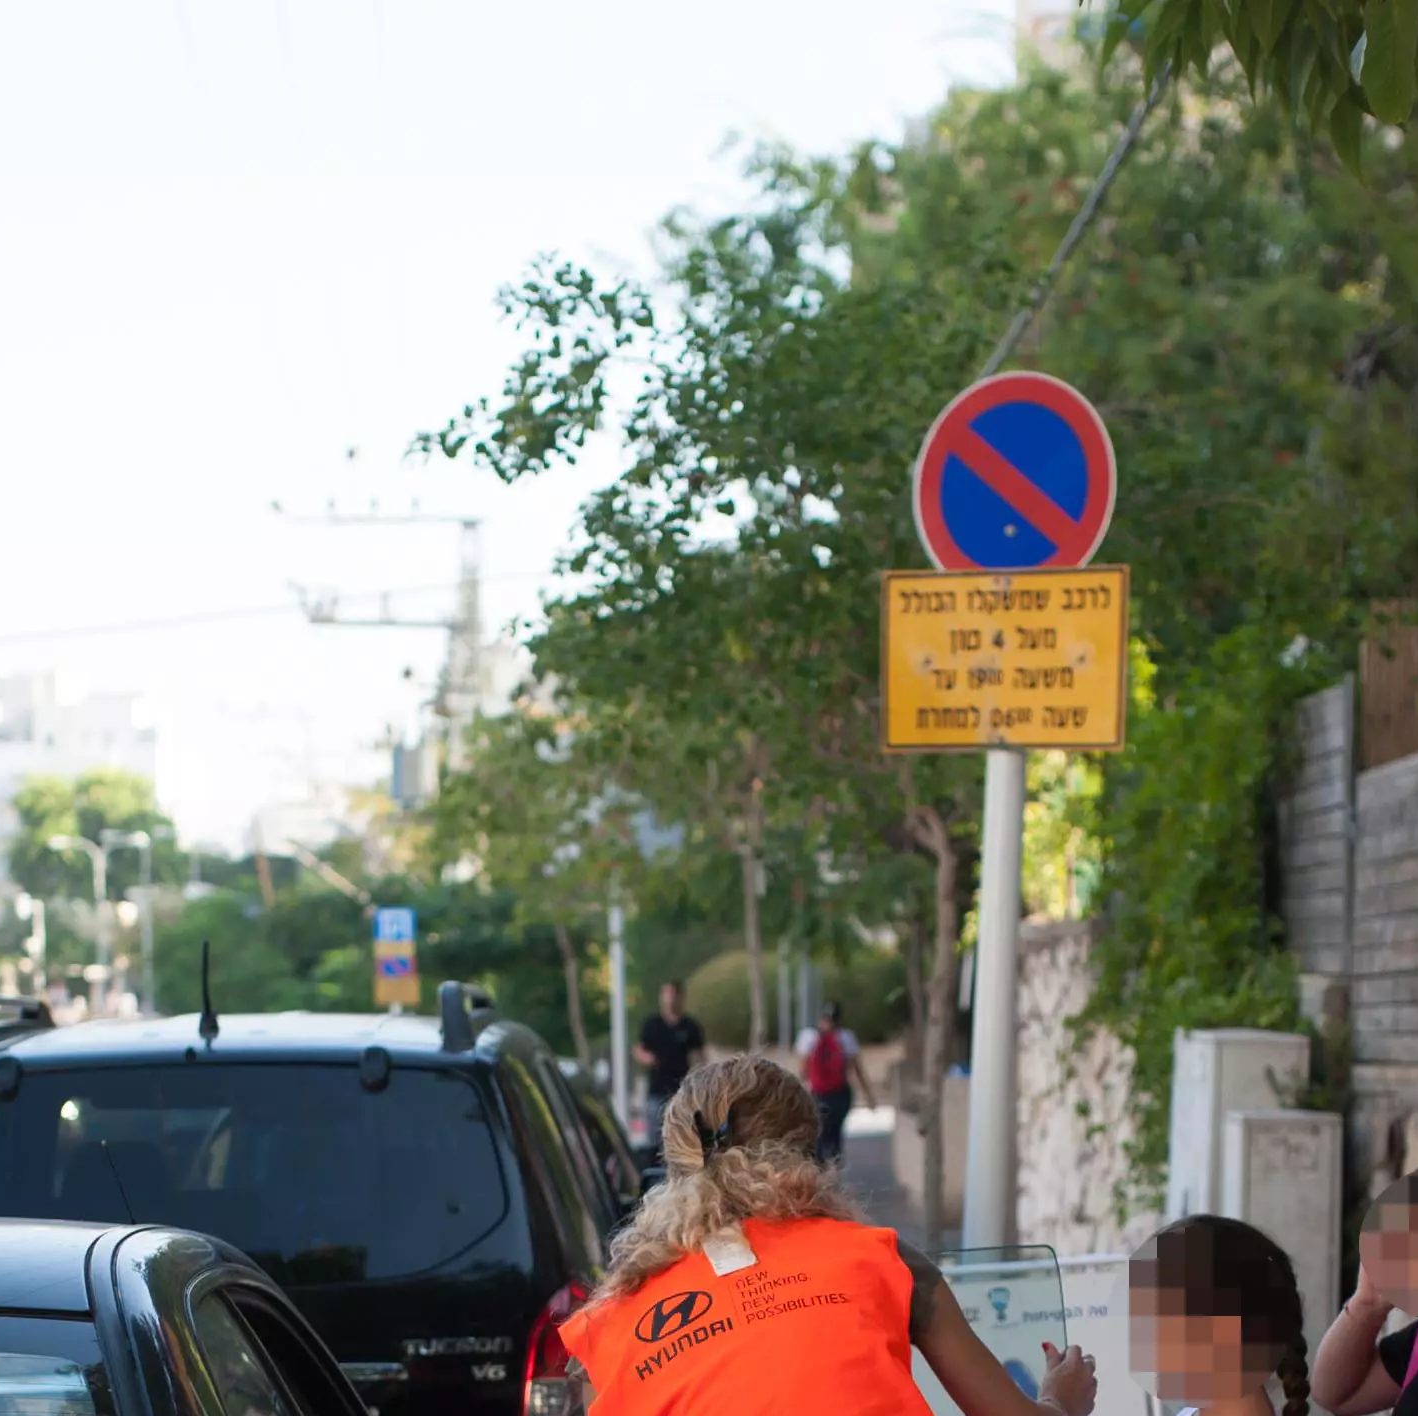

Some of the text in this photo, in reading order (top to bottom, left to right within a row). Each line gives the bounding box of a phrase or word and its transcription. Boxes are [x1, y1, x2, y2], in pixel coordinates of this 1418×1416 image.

[899, 584, 1112, 615] לרכב שמשקלו הכולל
[991, 629, 1006, 649] 4
[1015, 624, 1058, 650] מעל
[930, 668, 958, 691] עד
[1012, 666, 1075, 690] משעה
[915, 704, 981, 730] למחרת
[1041, 705, 1089, 728] שעה
[635, 1316, 734, 1381] HYUNDAI
[470, 1362, 507, 1381] V6
